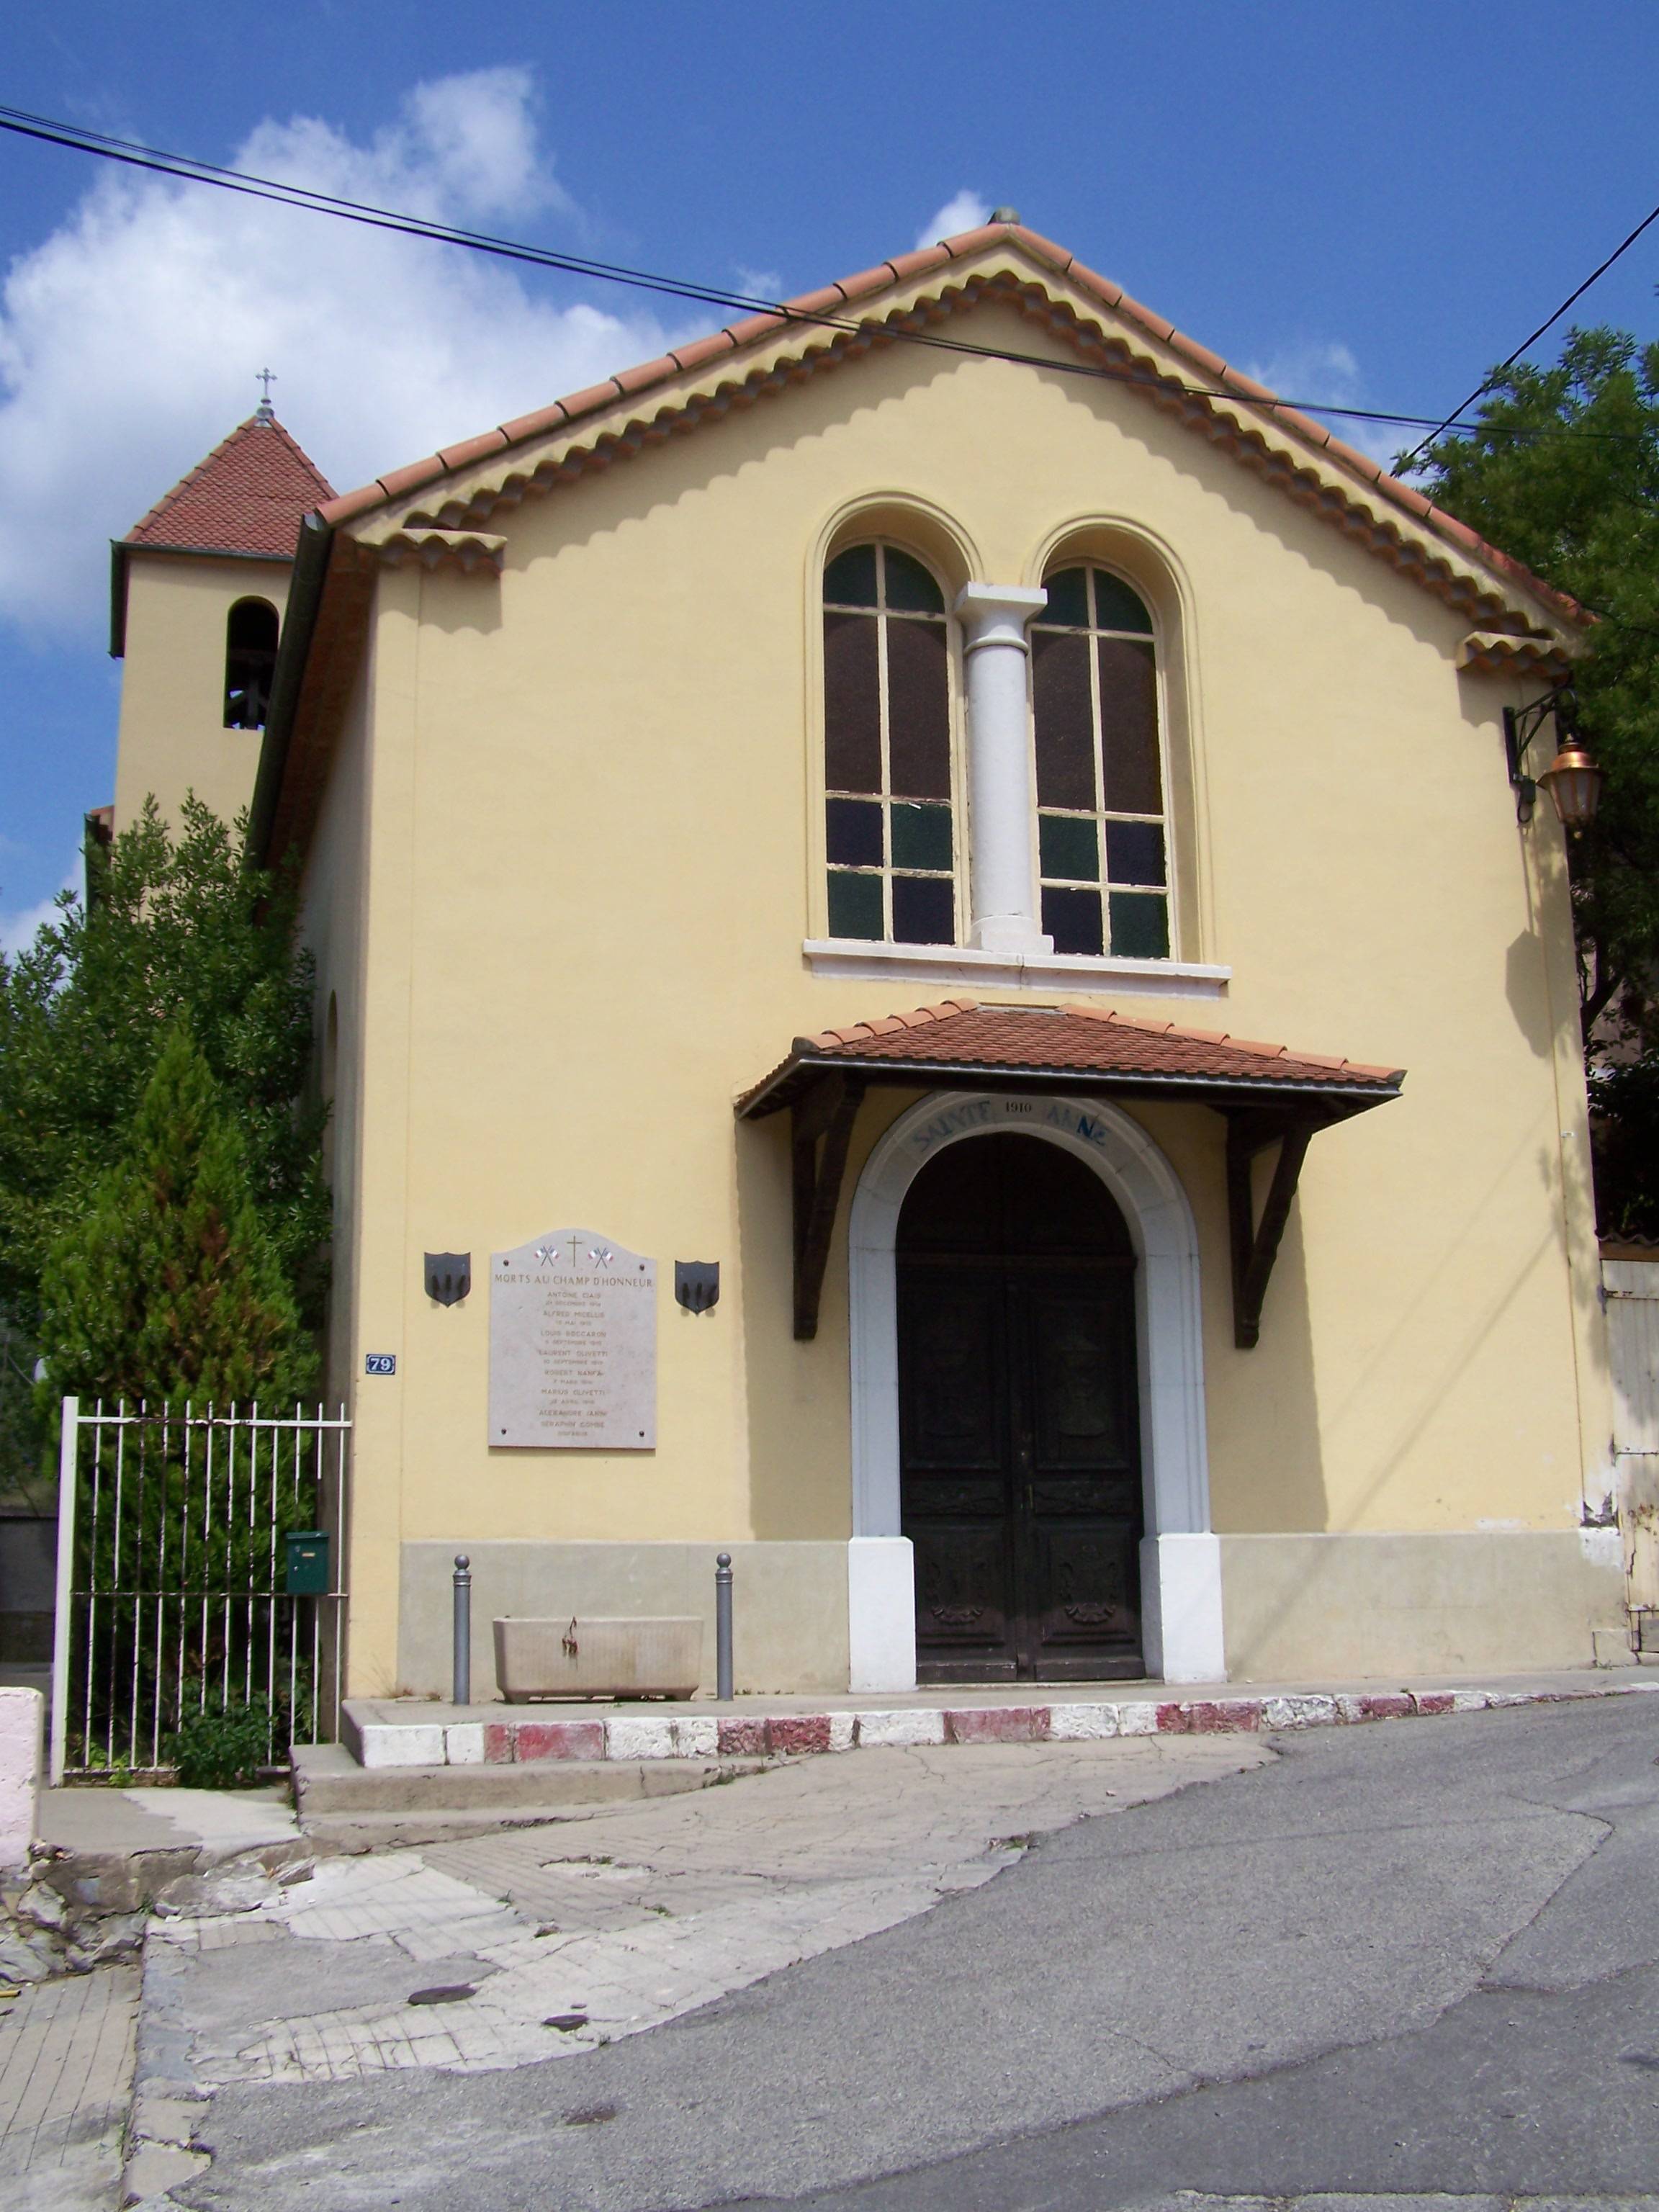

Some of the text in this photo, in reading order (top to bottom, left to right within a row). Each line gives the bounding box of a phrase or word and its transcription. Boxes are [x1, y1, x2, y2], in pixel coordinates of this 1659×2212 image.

[1005, 1102, 1032, 1112] 1910
[495, 1274, 652, 1287] MORTS AU CHAMP D'HONNEUR
[370, 1357, 391, 1371] 79
